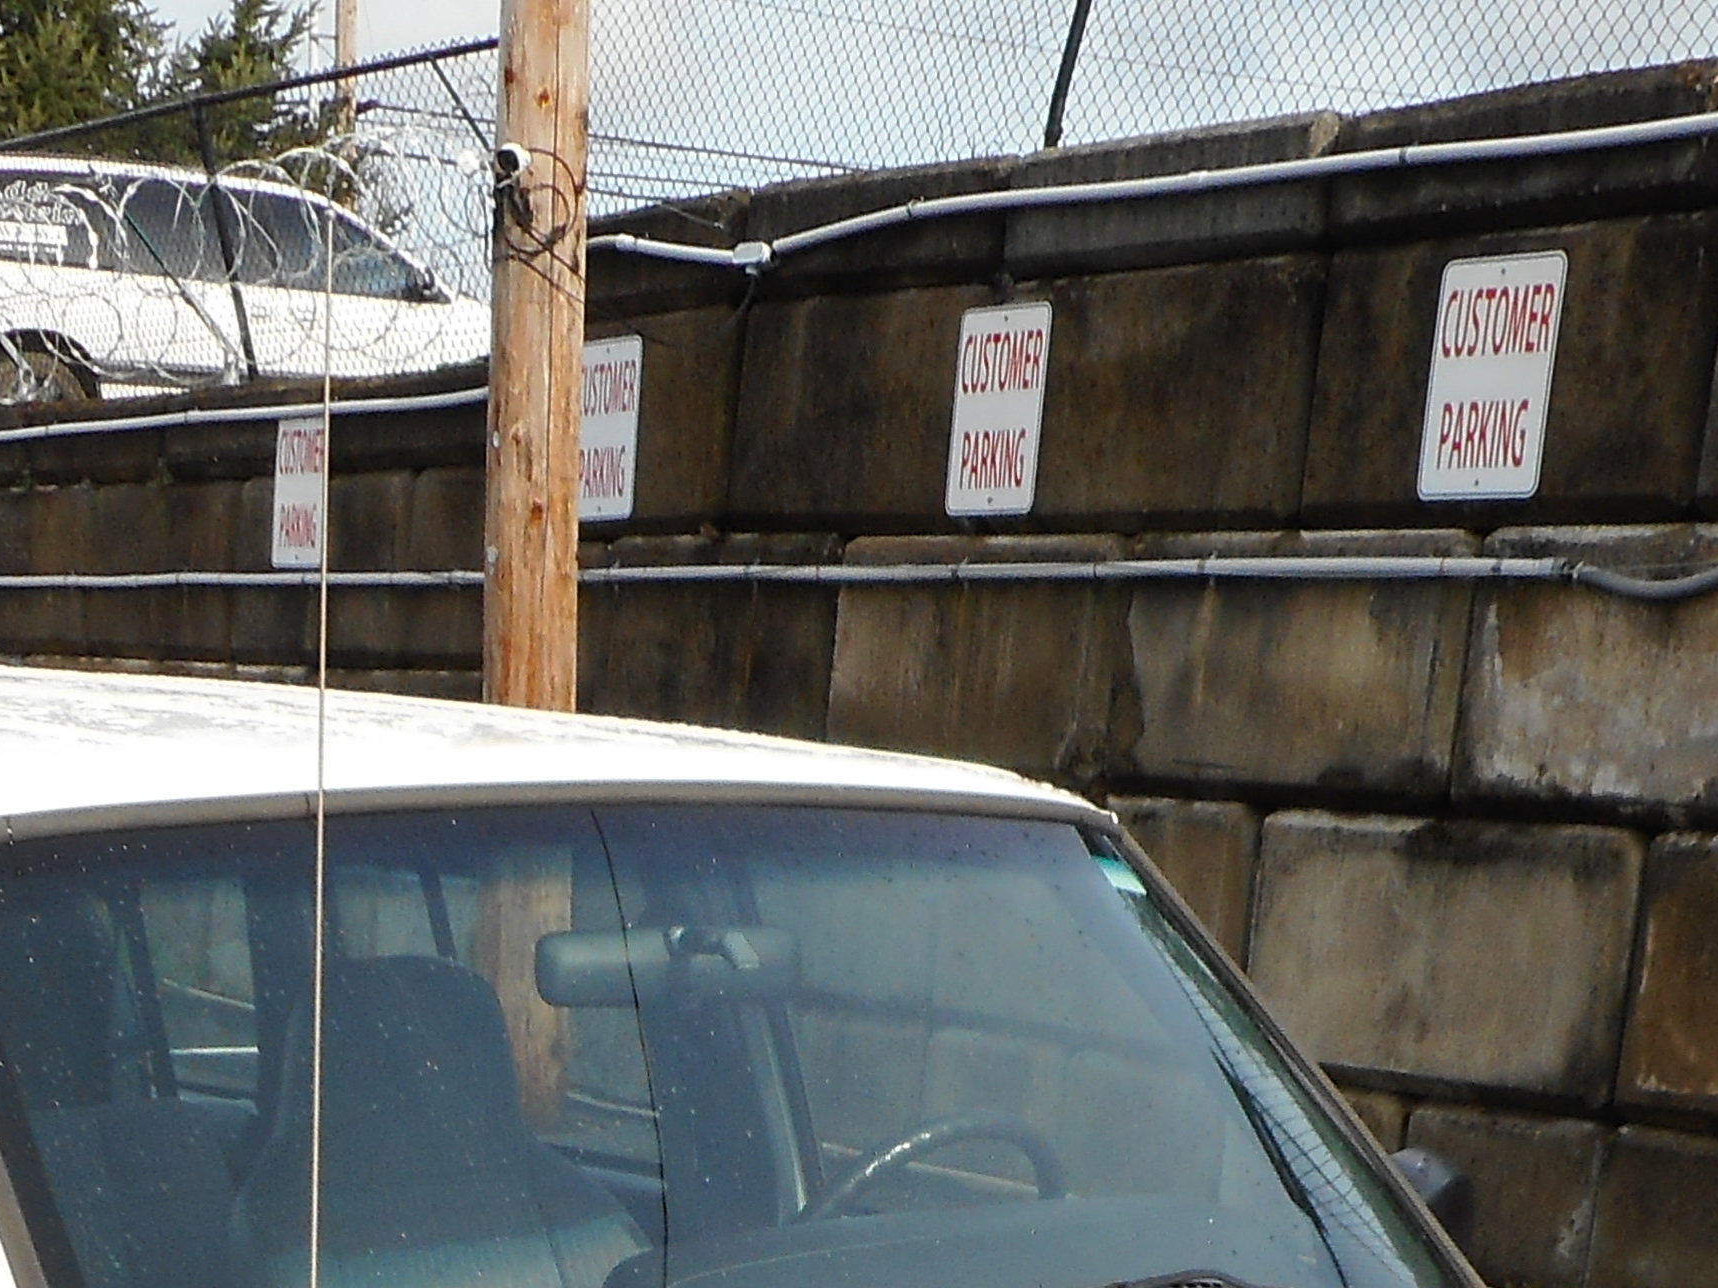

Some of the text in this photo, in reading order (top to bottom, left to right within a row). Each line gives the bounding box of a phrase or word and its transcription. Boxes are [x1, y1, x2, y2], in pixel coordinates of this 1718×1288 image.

[1441, 283, 1556, 358] CUSTOMER
[580, 359, 637, 417] USTOMER
[961, 328, 1044, 394] CUSTOMER
[959, 428, 1026, 490] PARKING
[1436, 398, 1530, 470] PARKING
